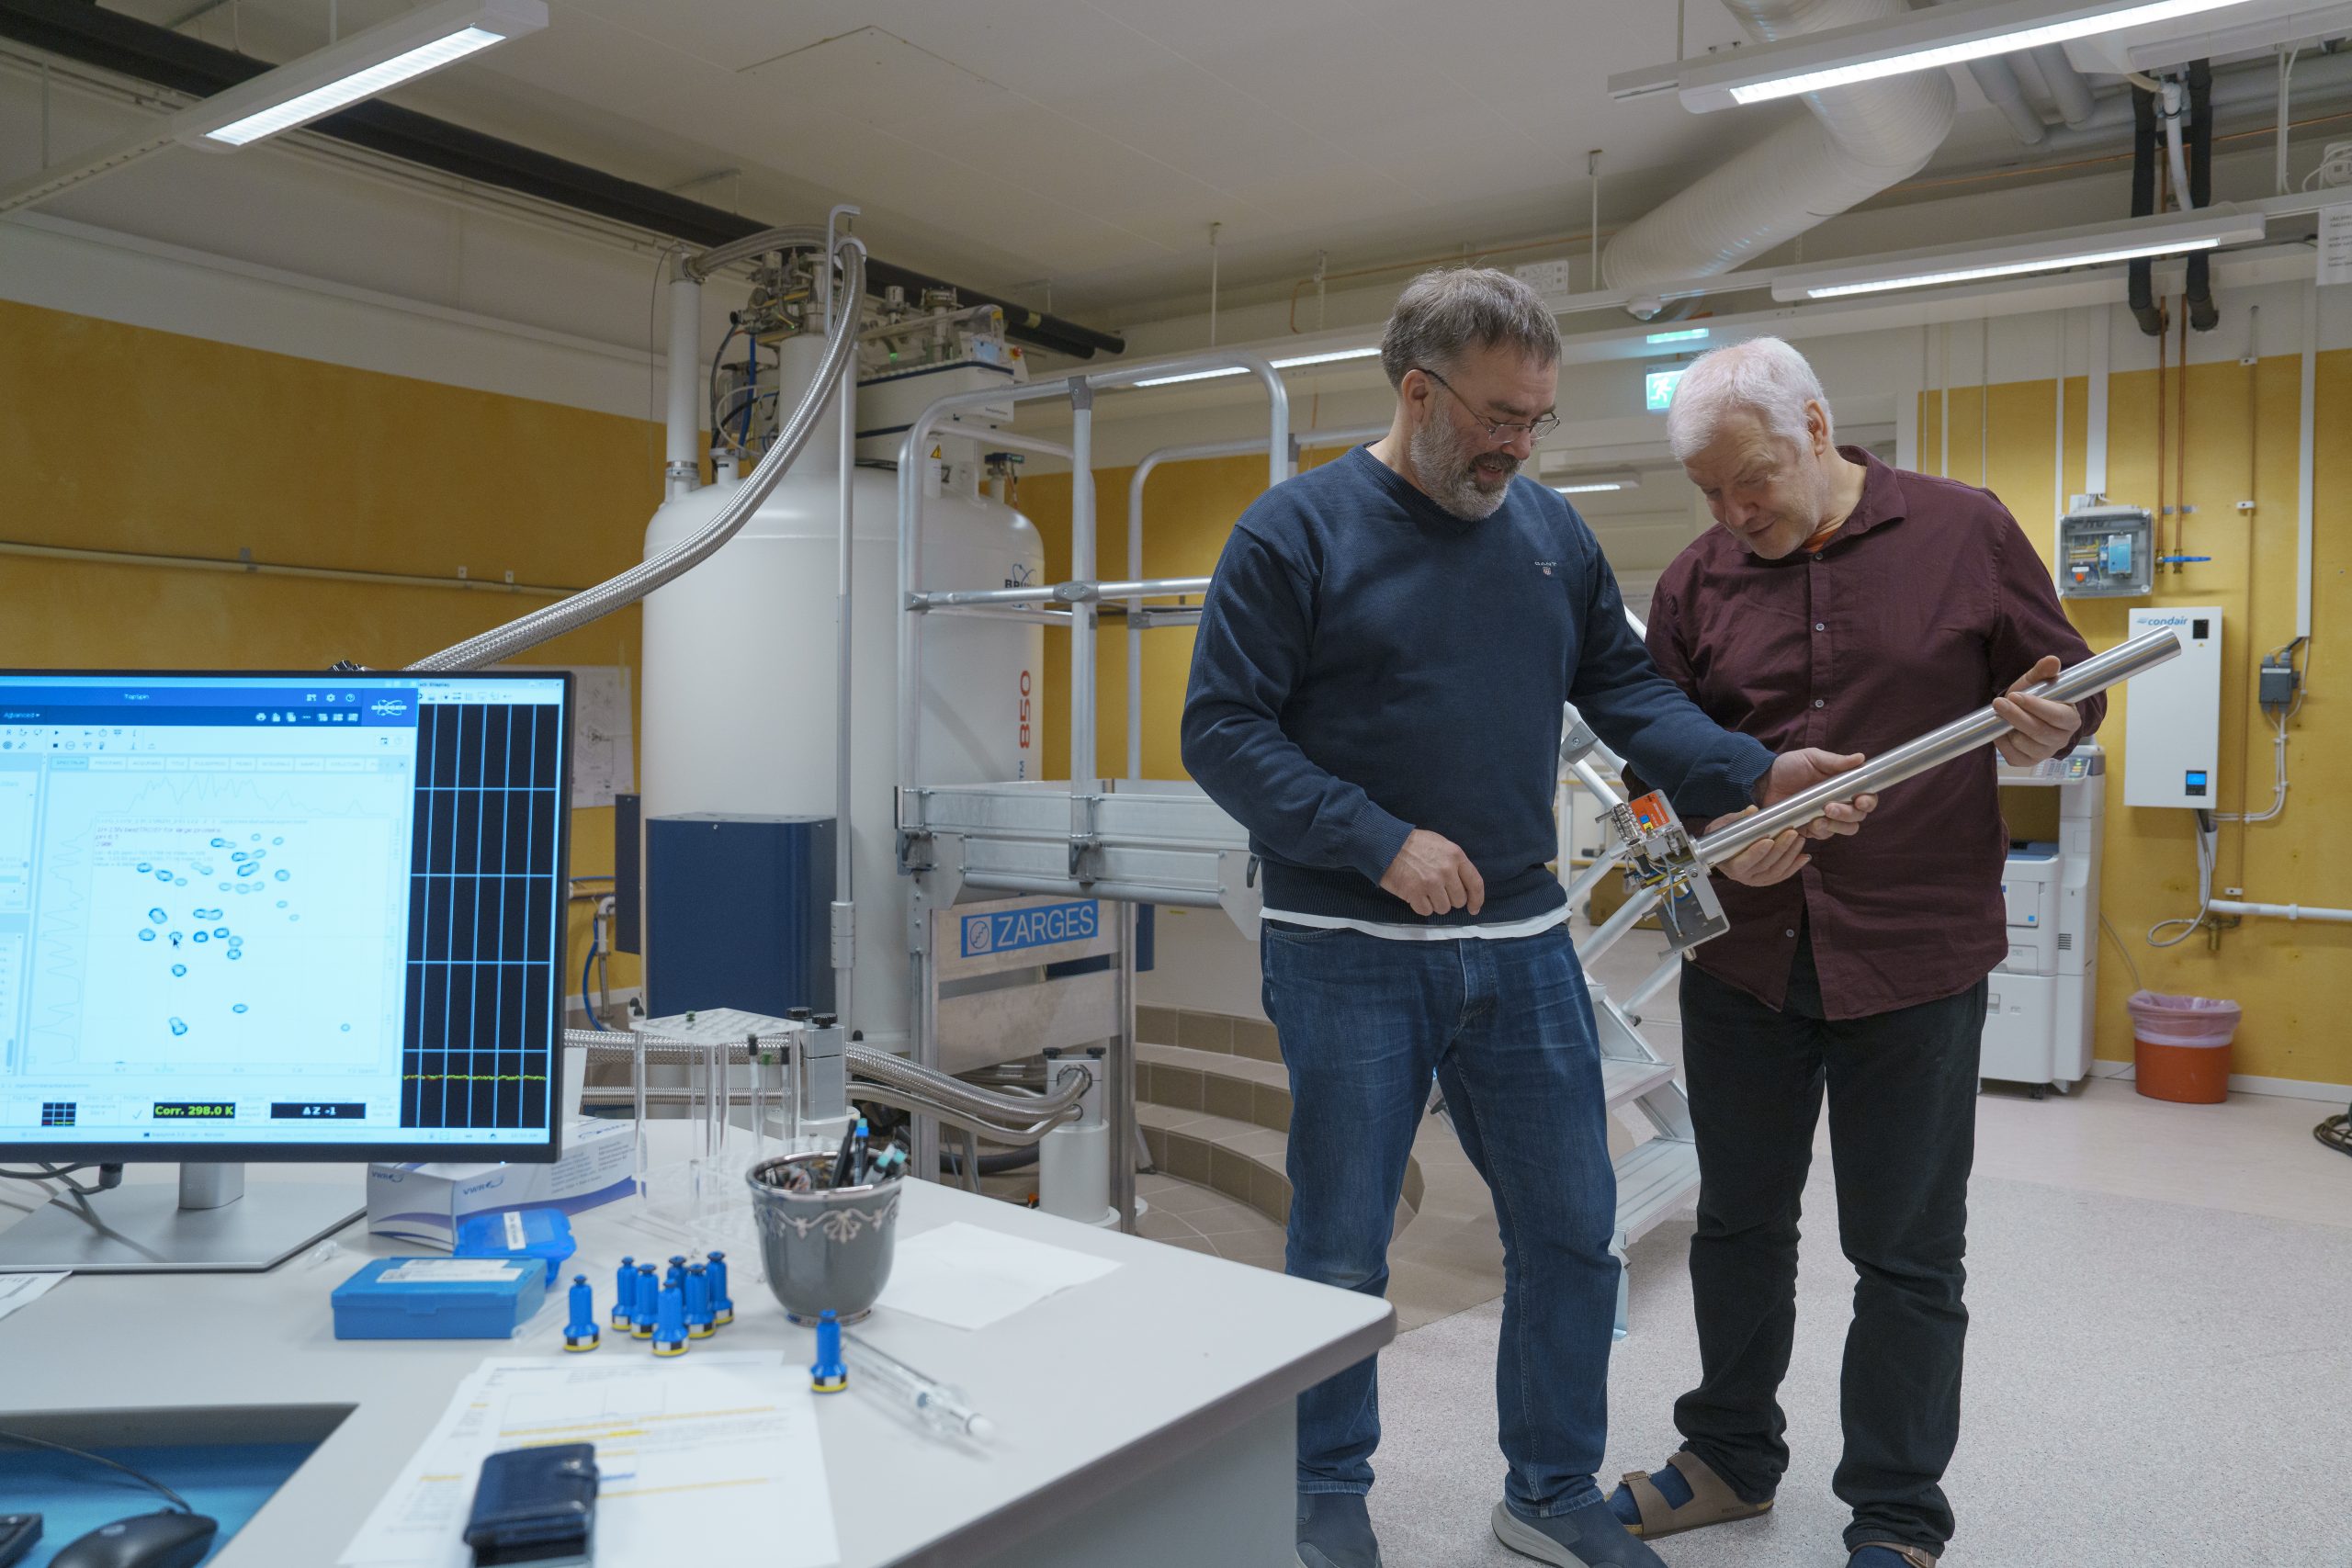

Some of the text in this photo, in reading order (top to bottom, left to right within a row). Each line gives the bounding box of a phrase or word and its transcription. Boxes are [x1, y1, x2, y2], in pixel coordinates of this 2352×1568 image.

[2148, 615, 2188, 626] condair
[1020, 670, 1031, 749] 850
[997, 905, 1094, 947] ZARGES
[154, 1105, 185, 1116] Corr.
[187, 1105, 221, 1116] 298.0
[225, 1105, 234, 1116] K
